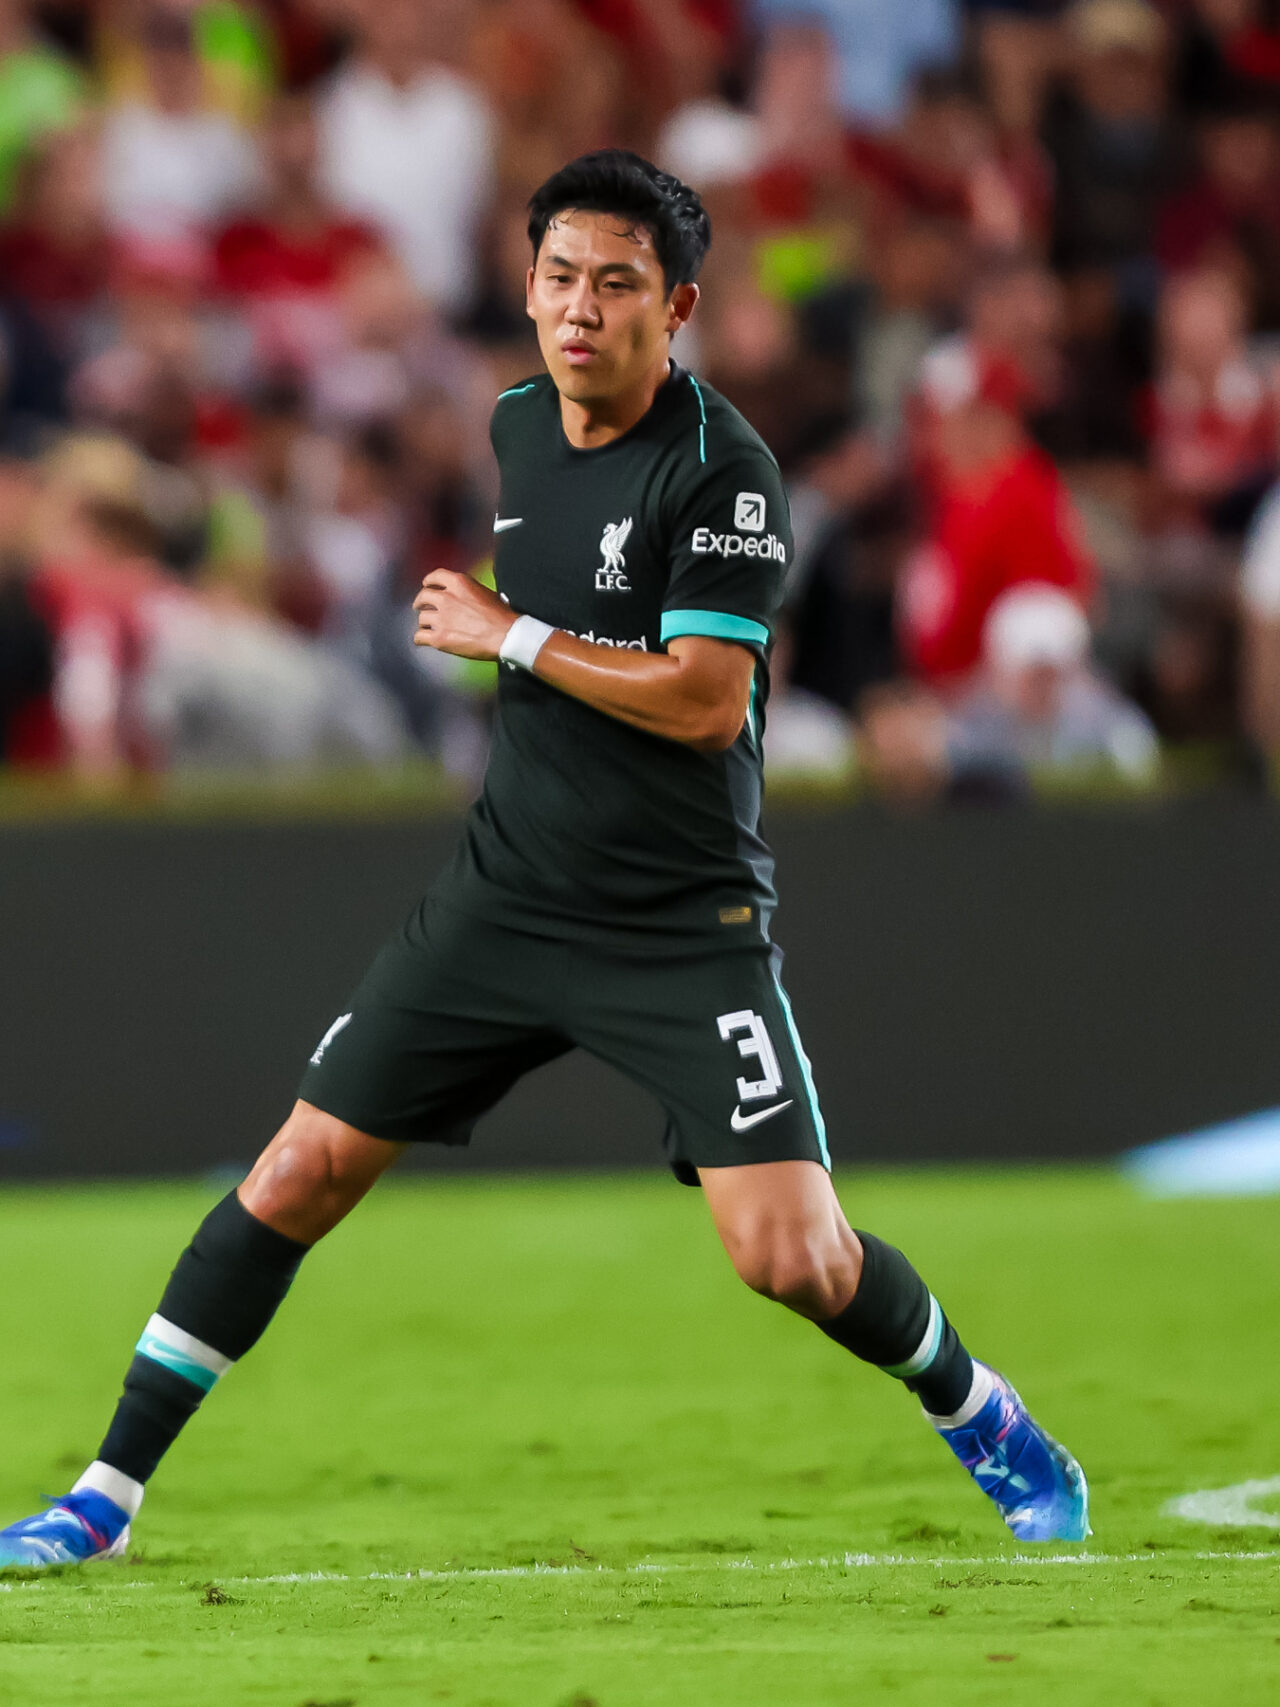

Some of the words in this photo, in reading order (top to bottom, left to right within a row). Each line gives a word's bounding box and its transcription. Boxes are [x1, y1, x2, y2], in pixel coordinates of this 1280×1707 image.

[691, 527, 785, 563] Expedia
[562, 629, 647, 652] dard
[716, 1009, 783, 1101] 3
